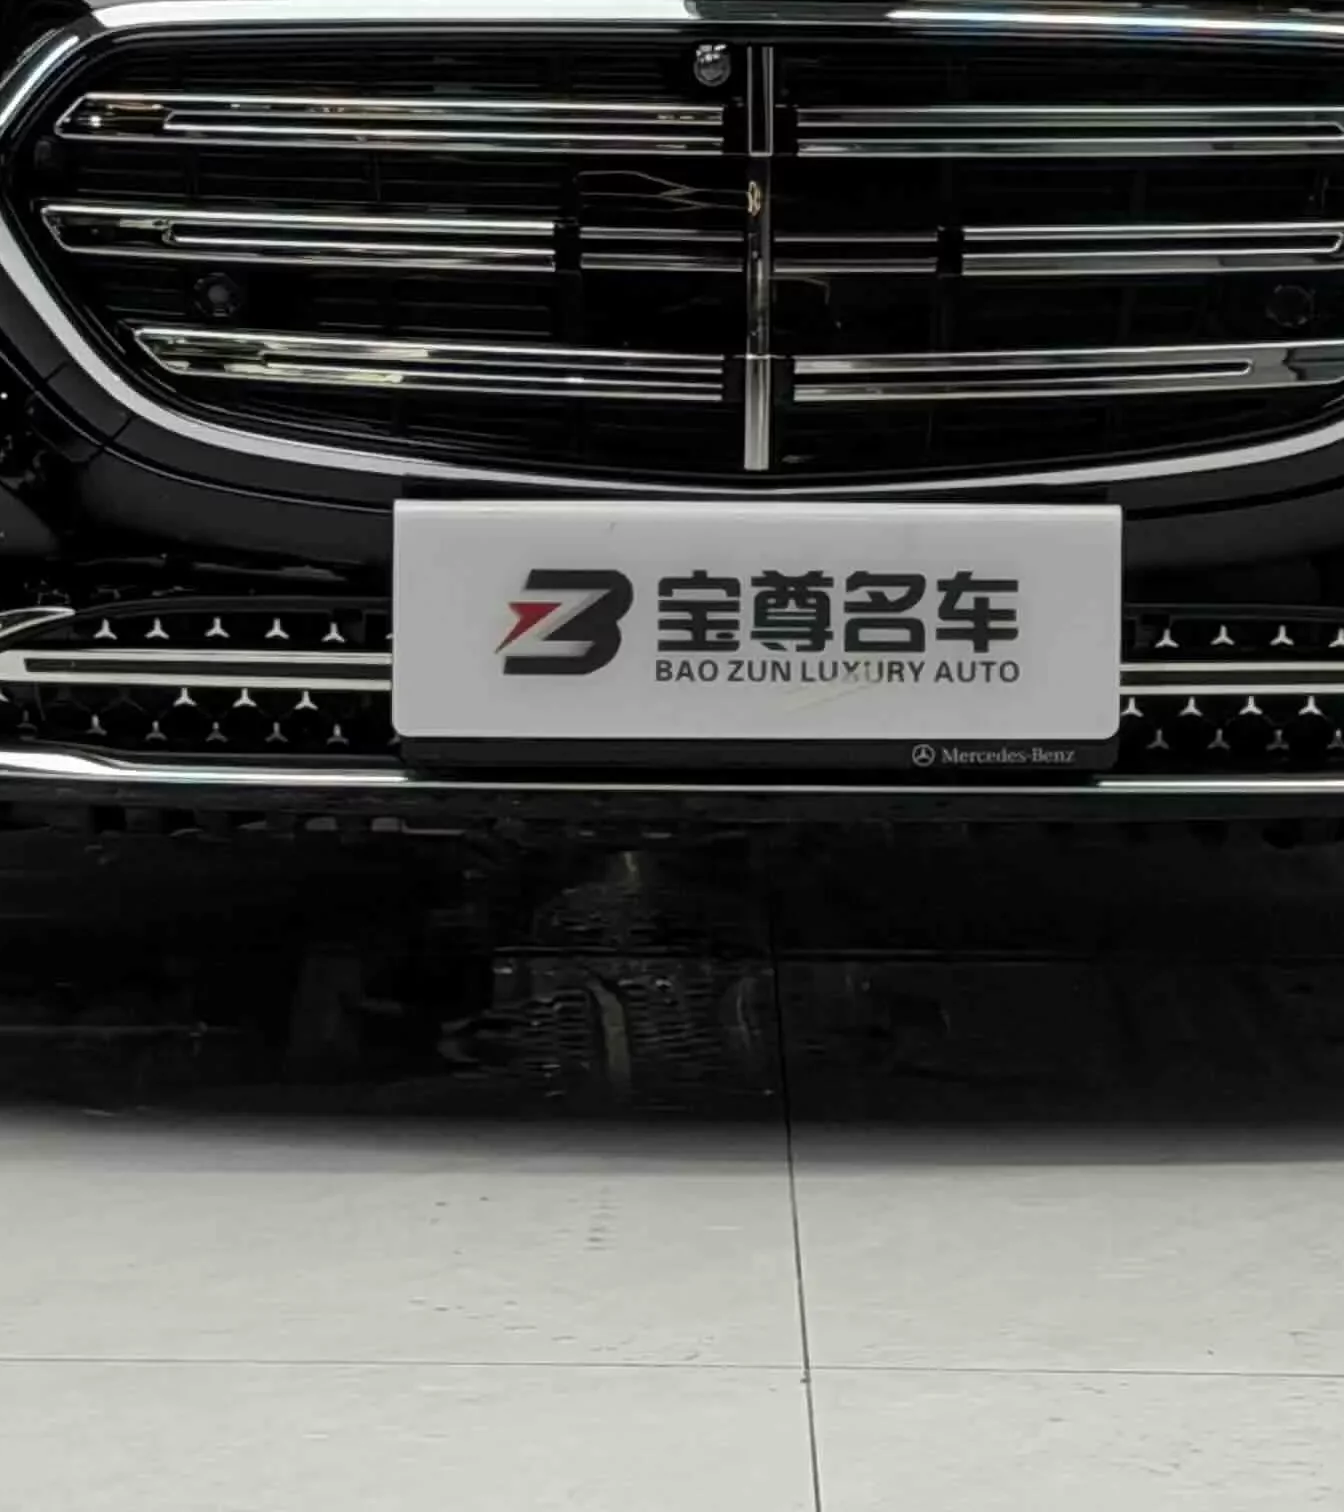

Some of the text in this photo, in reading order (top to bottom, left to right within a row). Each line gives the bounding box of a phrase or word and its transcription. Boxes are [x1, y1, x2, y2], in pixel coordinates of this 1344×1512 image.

[658, 569, 1018, 653] 宝尊名车
[656, 660, 1020, 683] BAO ZUN LUXURY AUTO
[942, 746, 1075, 764] Mercedes-Benz
